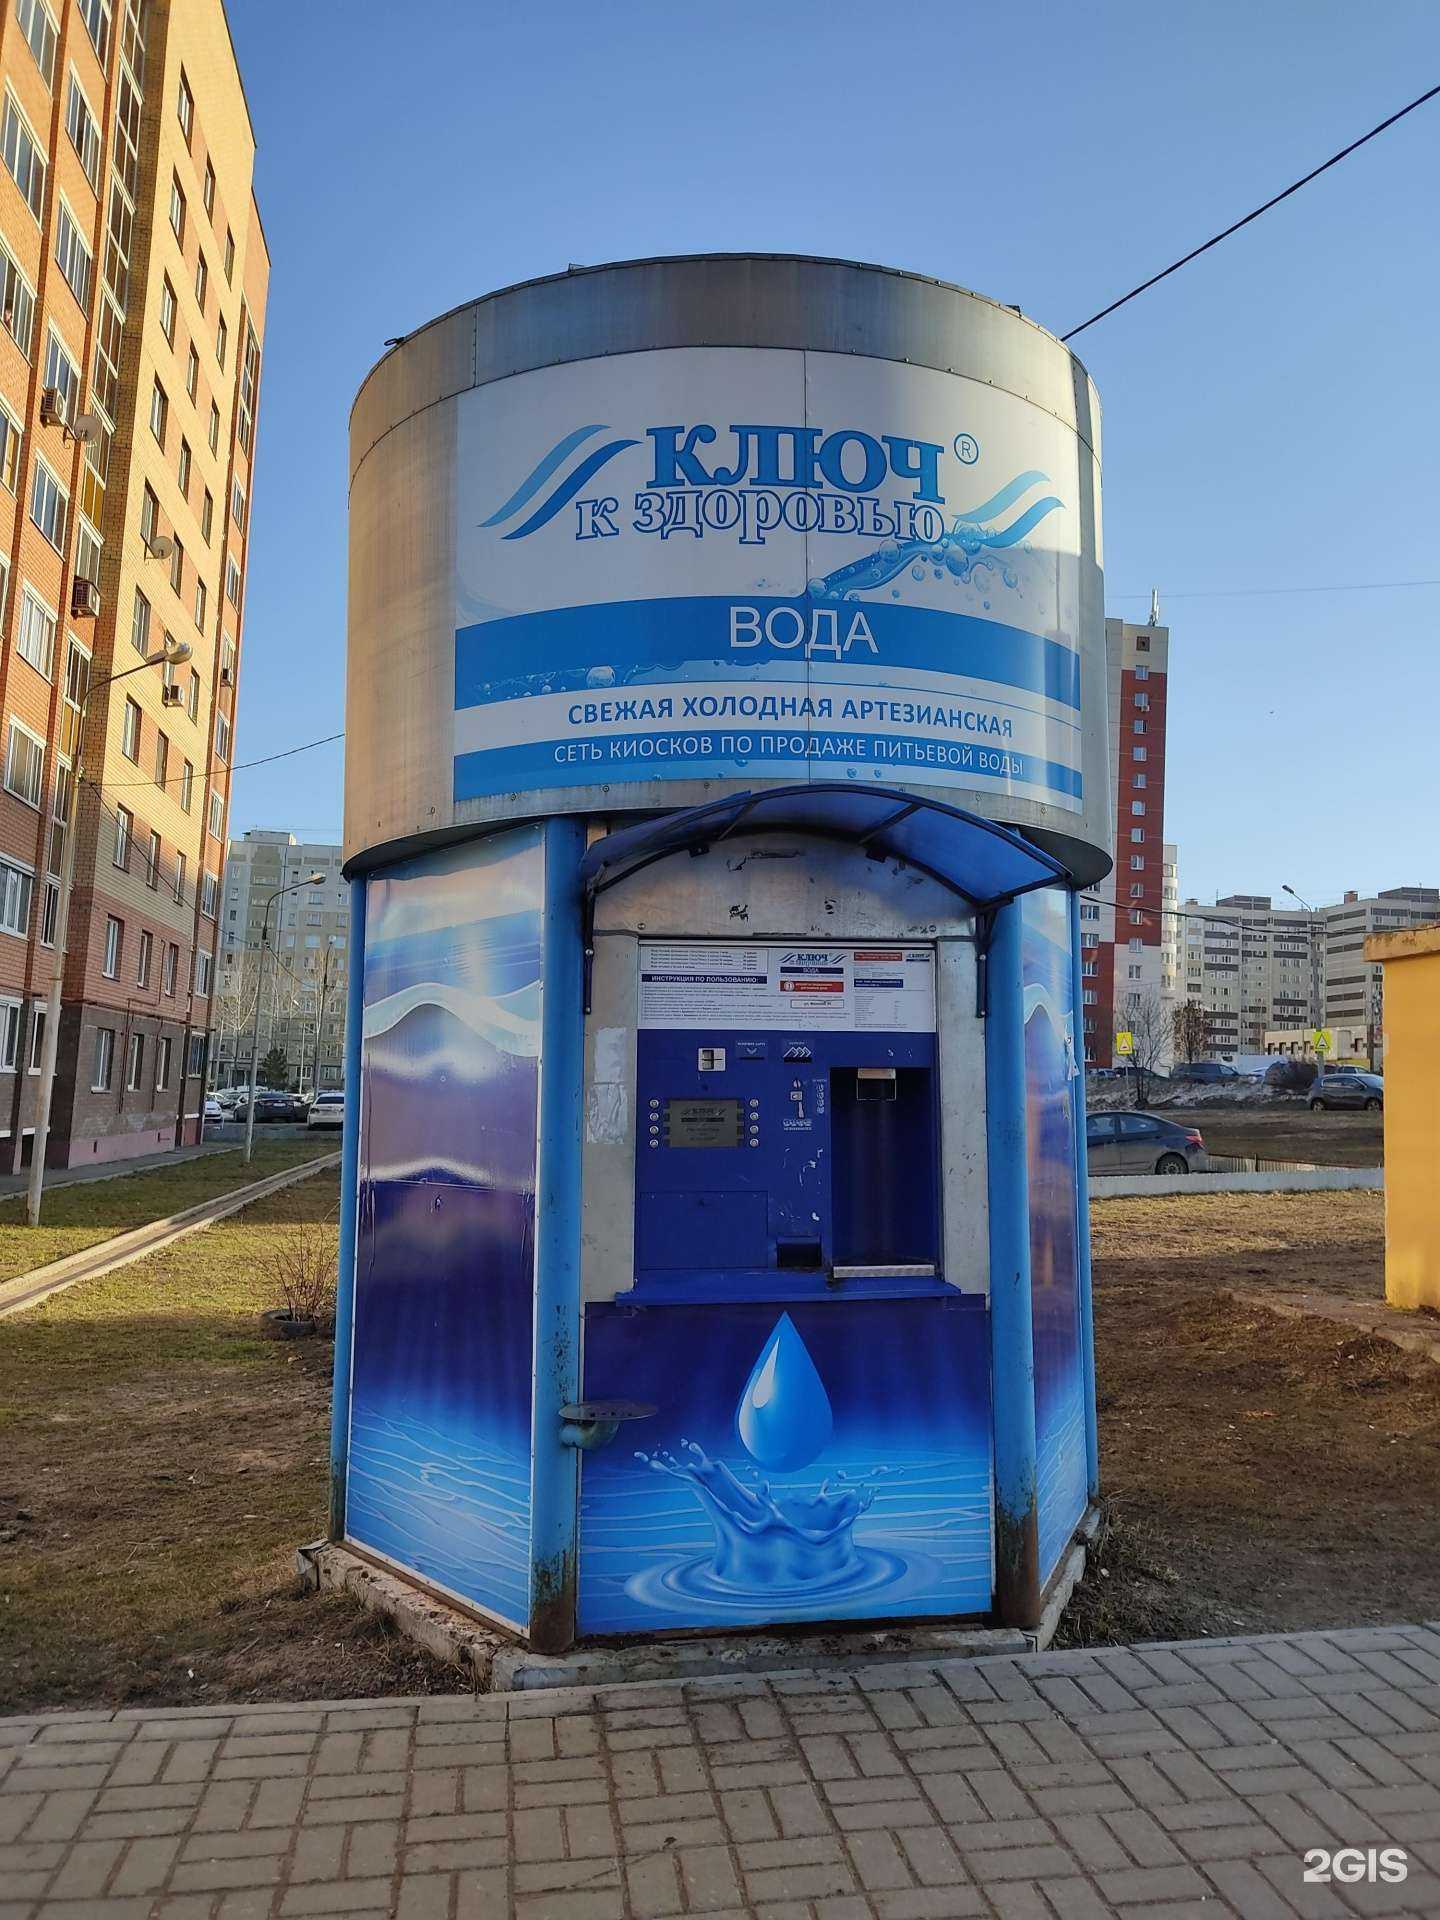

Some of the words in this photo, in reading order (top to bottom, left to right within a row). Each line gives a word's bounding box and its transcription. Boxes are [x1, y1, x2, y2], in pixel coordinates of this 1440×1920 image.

[645, 424, 946, 505] КЛЮЧ
[730, 606, 880, 660] ВОДА
[568, 698, 674, 725] СВЕЖАЯ
[682, 696, 833, 721] ХОЛОДНАЯ
[841, 699, 1013, 738] АРТЕЗИАНСКАЯ
[554, 742, 603, 763] СЕТЬ
[610, 736, 713, 759] КИОСКОВ
[721, 736, 753, 754] ПО
[761, 736, 867, 759] ПРОДАЖЕ
[874, 740, 974, 767] ПИТЬЕВОЙ
[979, 752, 1025, 777] ВОДЫ
